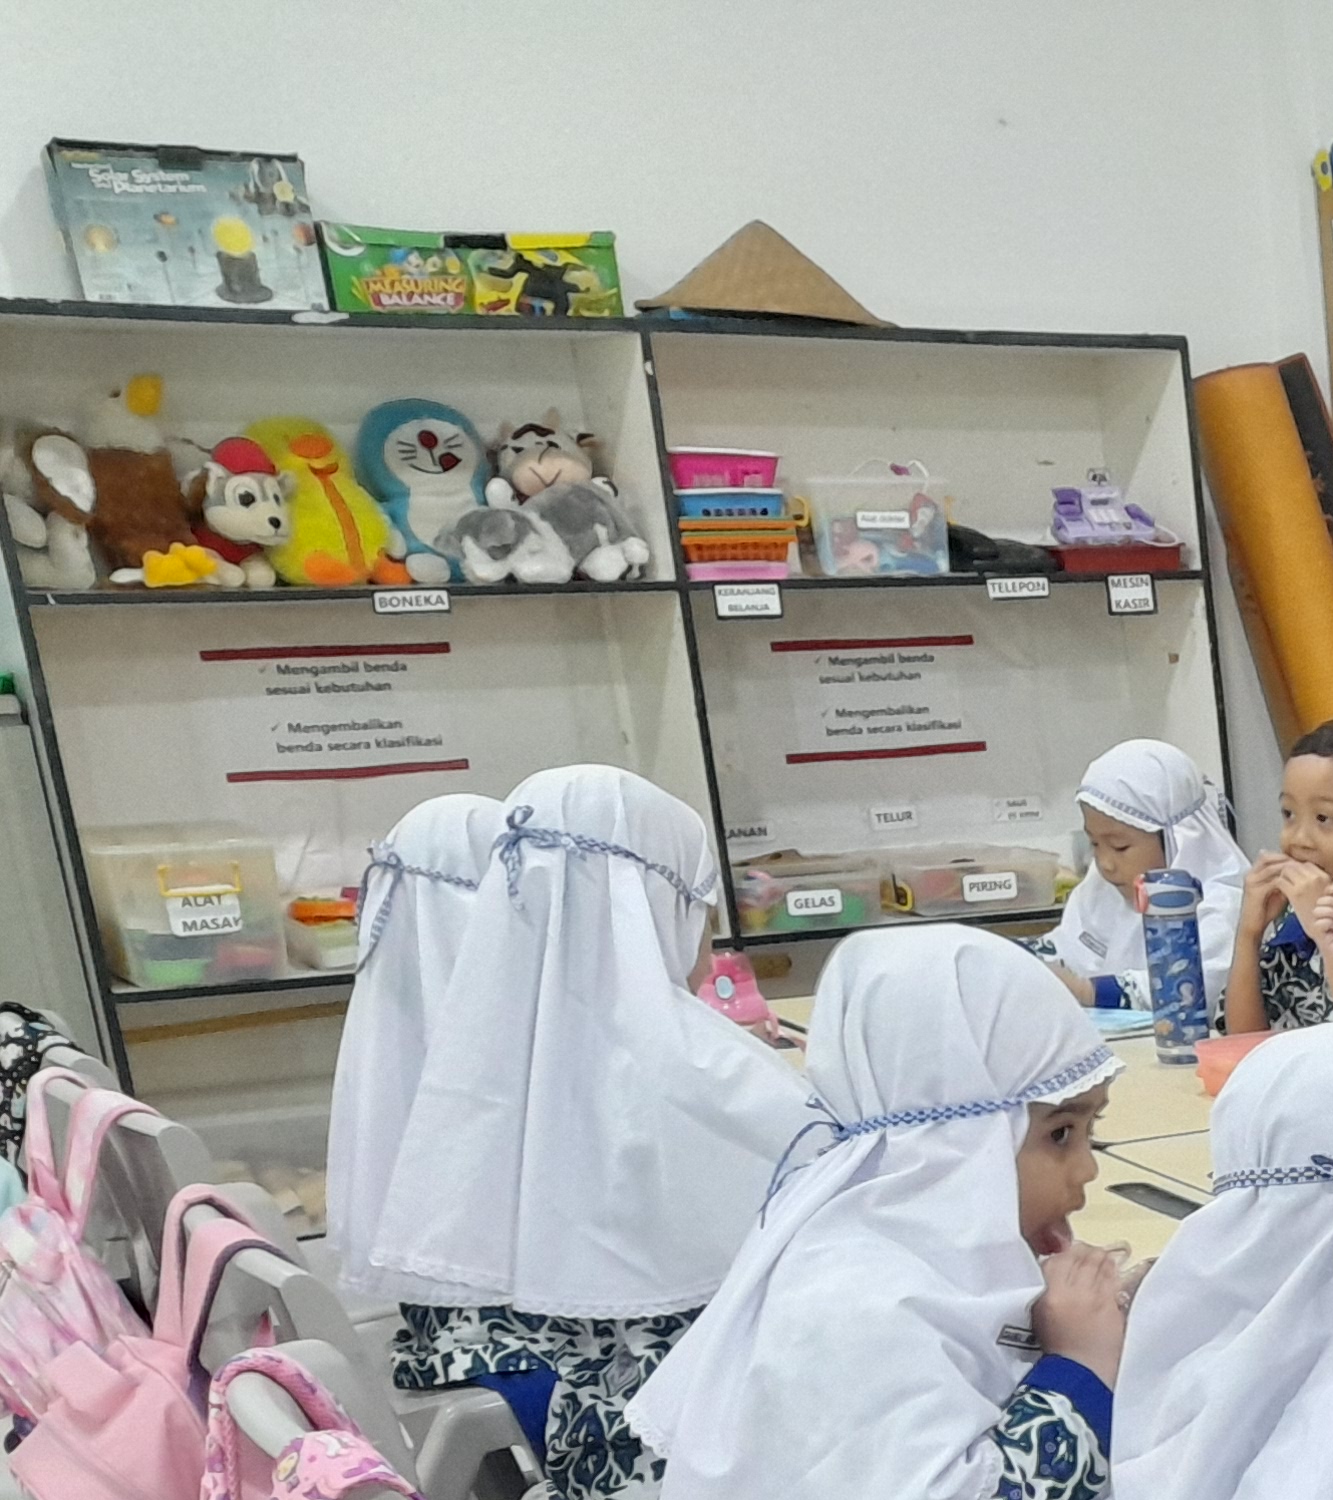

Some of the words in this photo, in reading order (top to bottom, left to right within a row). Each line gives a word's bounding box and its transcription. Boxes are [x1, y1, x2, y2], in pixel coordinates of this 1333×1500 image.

[131, 169, 190, 183] System
[113, 180, 208, 194] Planetarium
[367, 276, 465, 294] MEASURING
[380, 293, 455, 306] BALANCE
[990, 580, 1046, 594] TELEPON
[1111, 576, 1149, 589] MESIN
[378, 594, 446, 609] BONEKA
[1114, 598, 1150, 610] KASIR
[276, 662, 359, 677] Mengambil
[363, 660, 408, 672] benda
[266, 684, 311, 696] sesuai
[315, 681, 392, 694] kebutuhan
[287, 718, 403, 735] Mengembalikan
[276, 741, 323, 753] benda
[327, 740, 371, 751] secara
[375, 734, 443, 749] klasifikasi
[875, 811, 913, 824] TELUR
[726, 826, 768, 839] ANAN
[968, 878, 1013, 893] PIRING
[793, 896, 836, 910] GELAS
